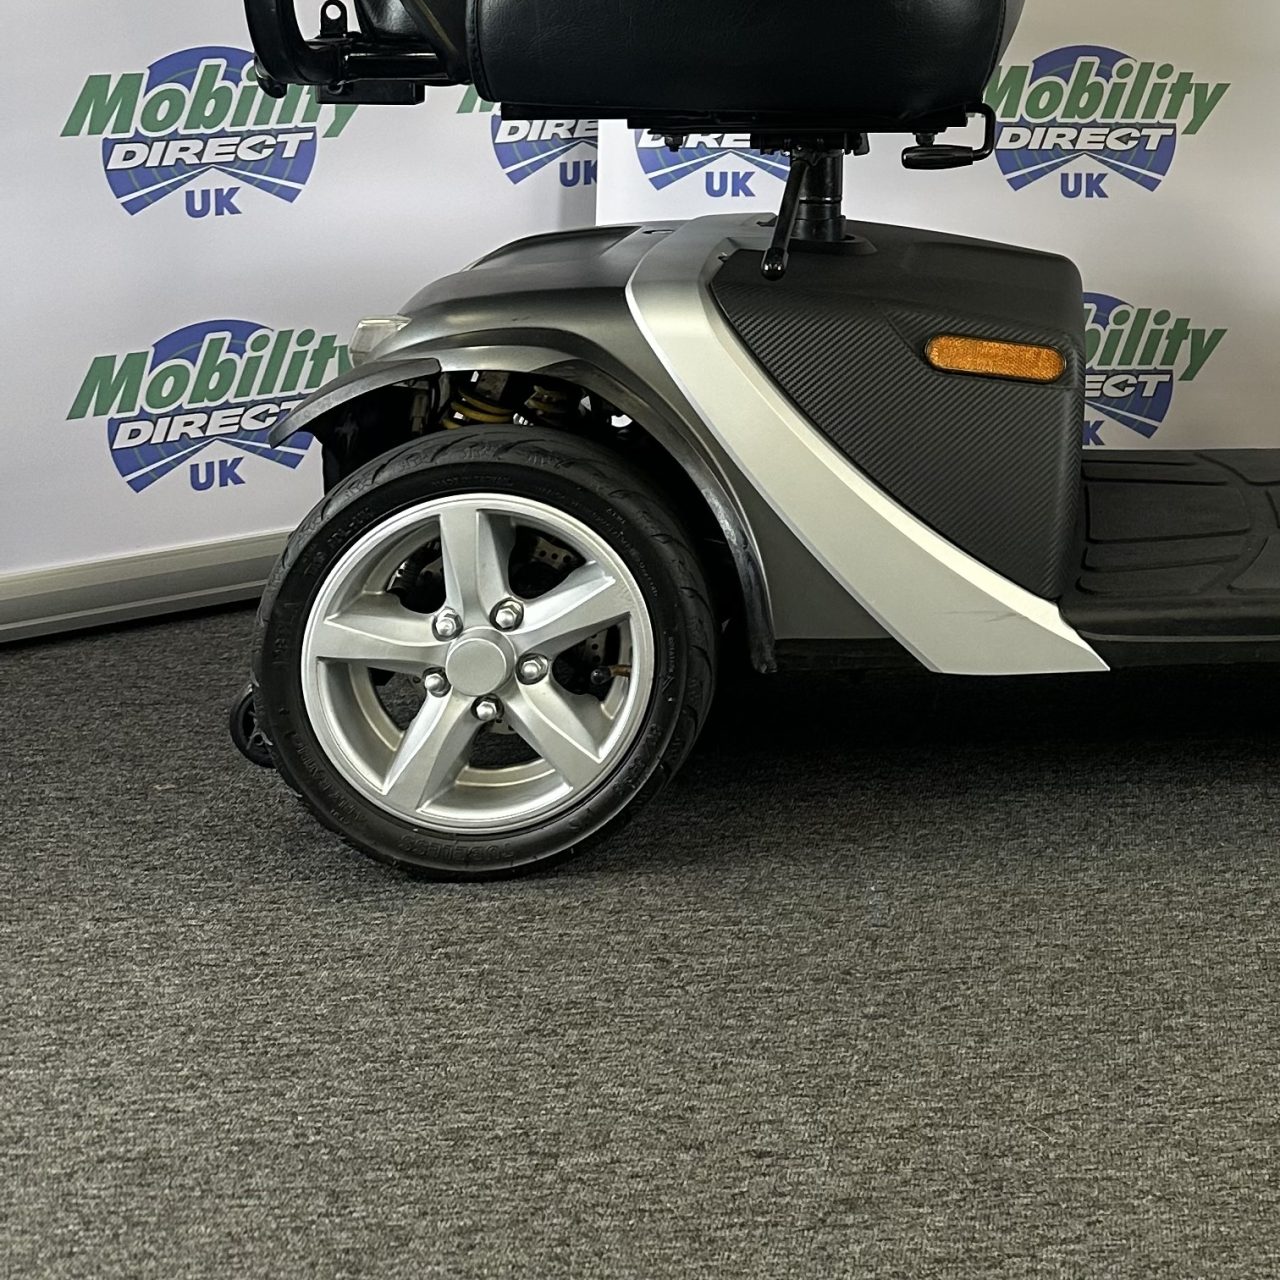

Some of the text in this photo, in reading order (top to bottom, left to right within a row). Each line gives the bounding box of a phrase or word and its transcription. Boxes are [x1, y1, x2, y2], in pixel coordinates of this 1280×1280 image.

[495, 120, 598, 144] DIRE
[996, 127, 1174, 151] DIRECT
[106, 132, 313, 170] DIRECT
[559, 160, 598, 188] UK
[705, 171, 755, 198] UK
[1060, 173, 1109, 199] UK
[185, 187, 242, 218] UK
[1083, 308, 1228, 381] ility
[1085, 374, 1171, 398] ECT
[1082, 420, 1106, 446] K
[190, 456, 246, 492] UK
